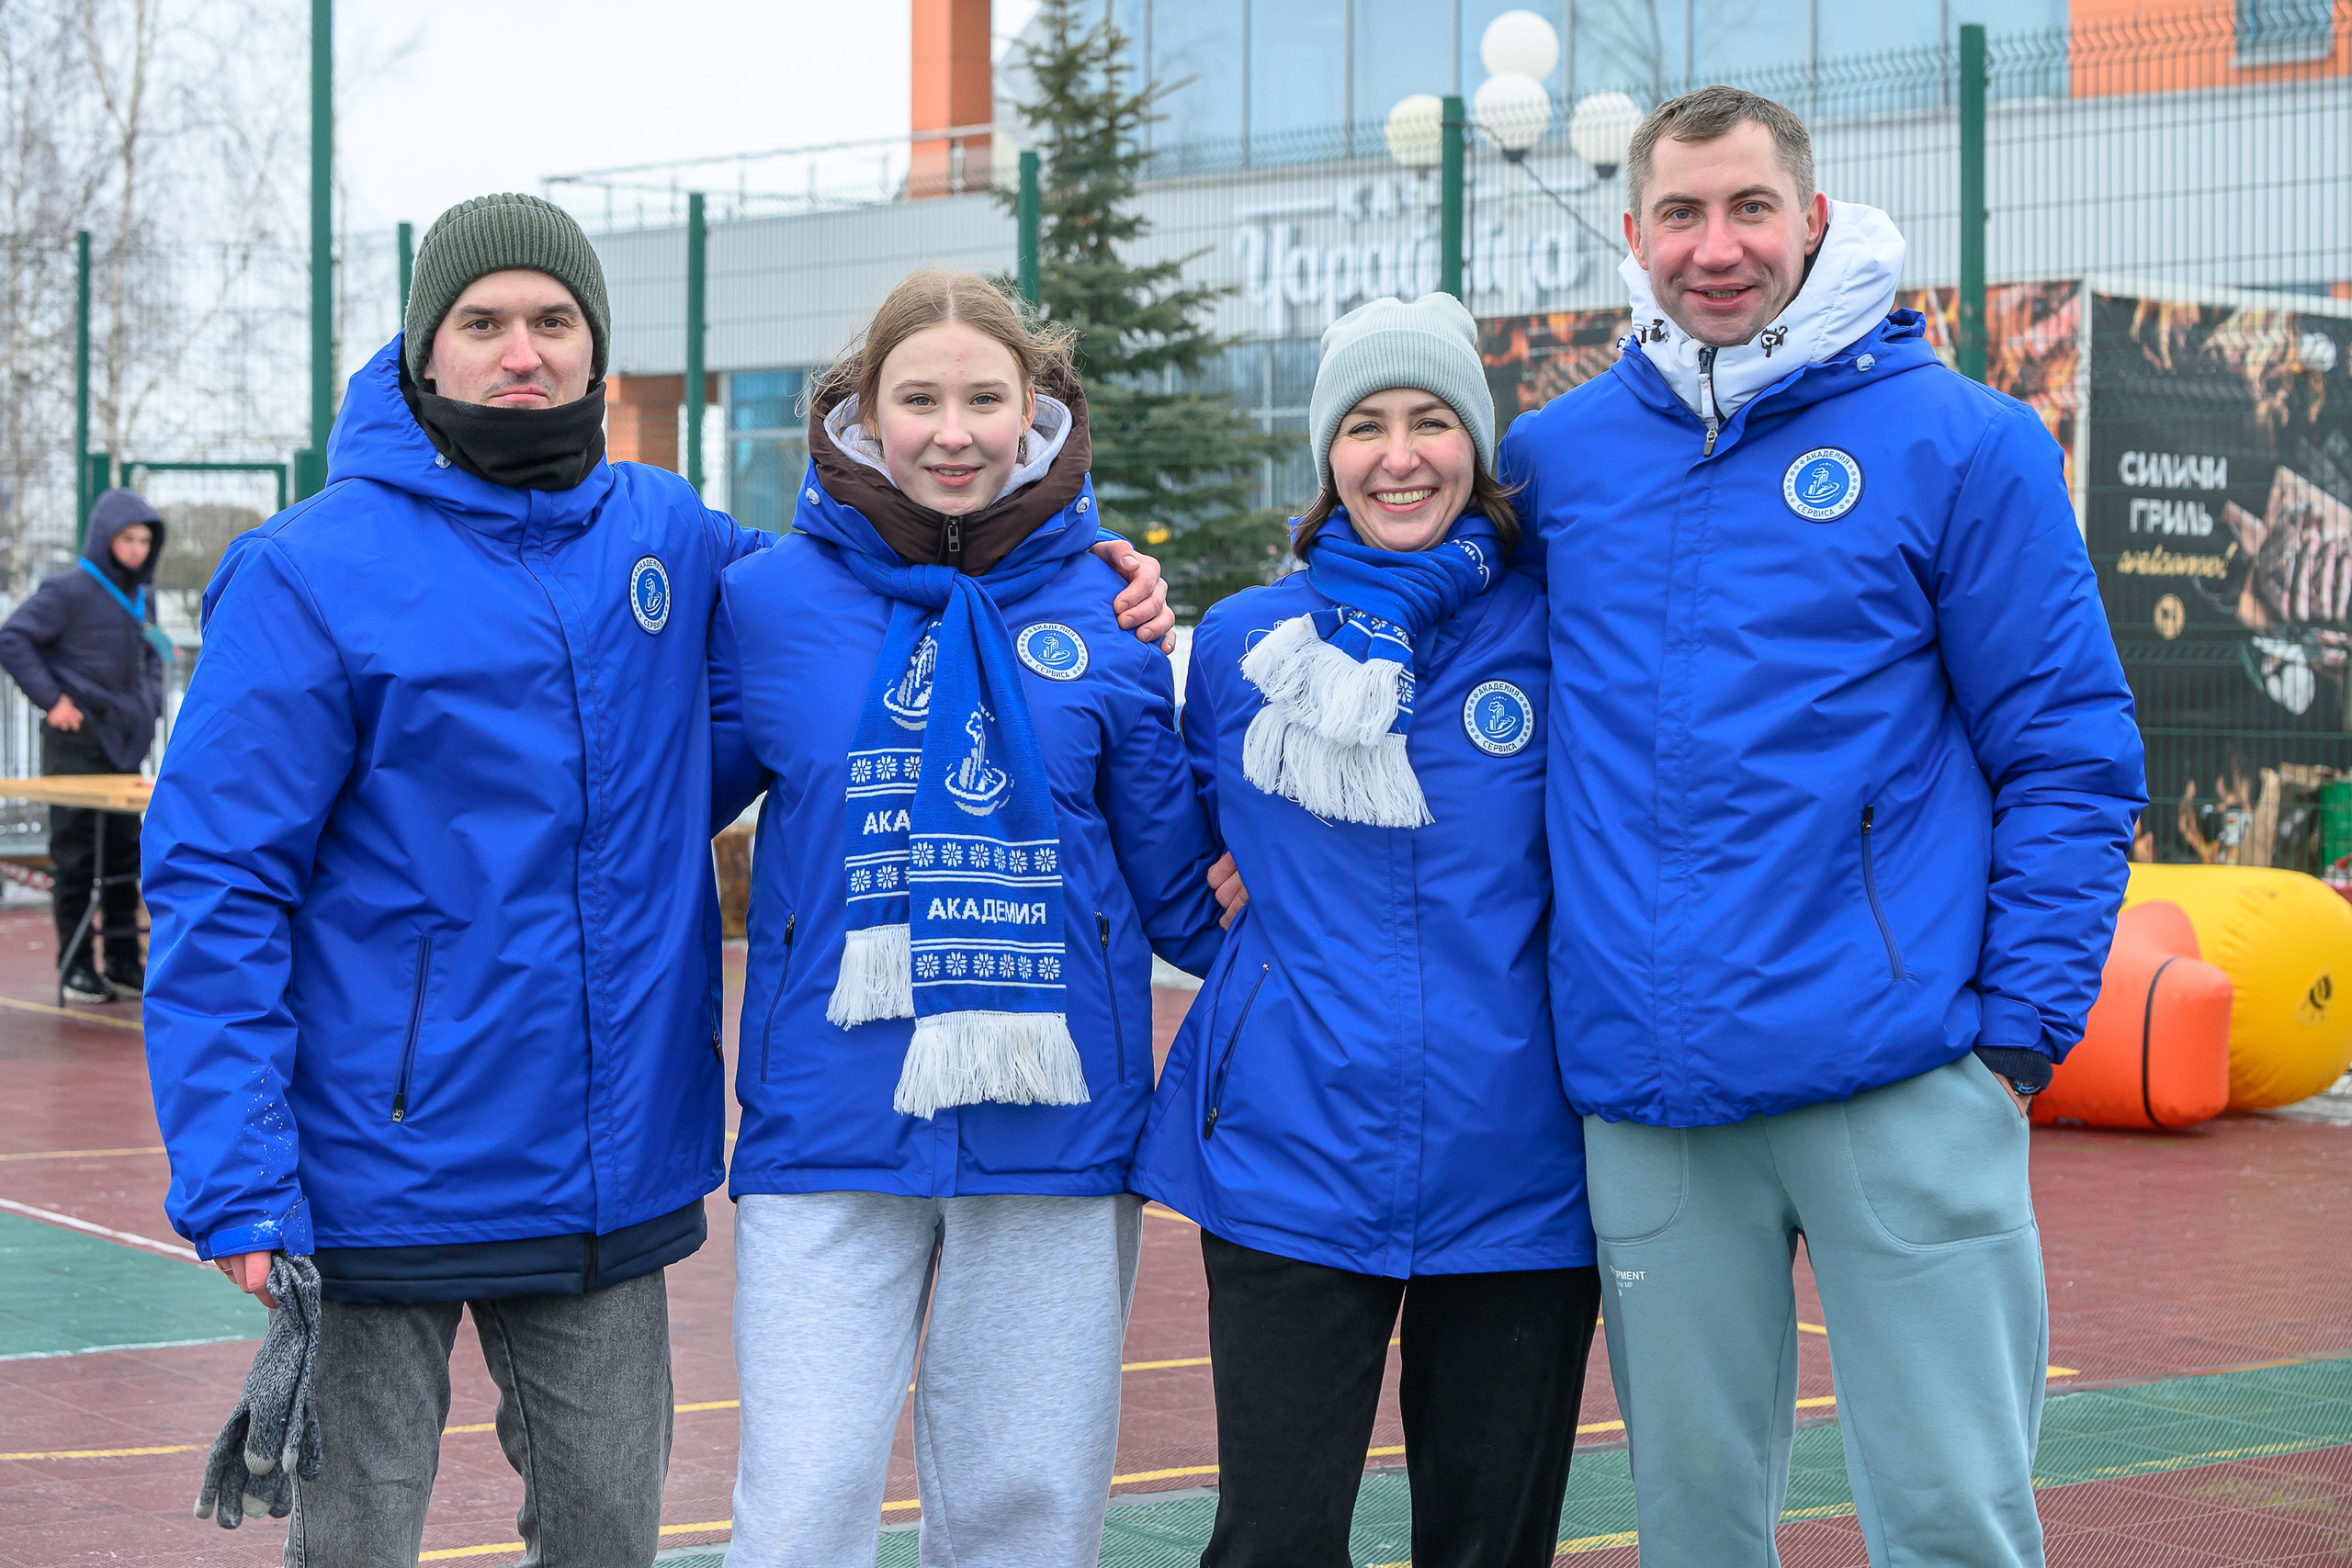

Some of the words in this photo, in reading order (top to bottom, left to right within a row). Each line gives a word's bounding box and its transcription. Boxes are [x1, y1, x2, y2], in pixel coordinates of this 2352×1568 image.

[1805, 450, 1850, 466] АКАДЕМИЯ
[2119, 450, 2228, 491] СИЛИЧИ
[1796, 503, 1836, 517] СЕРВИСА
[2129, 497, 2214, 536] ГРИЛЬ
[636, 559, 662, 573] АКАДЕМИЯ
[643, 618, 663, 629] СЕРВИСА
[1033, 624, 1076, 637] АКАДЕМИЯ
[1035, 663, 1070, 679] СЕРВИСА
[1477, 682, 1521, 698] АКАДЕМИЯ
[1482, 740, 1518, 752] СЕРВИСА
[862, 808, 911, 836] АКА
[927, 897, 1046, 925] АКАДЕМИЯ
[1612, 1267, 1646, 1281] PMENT
